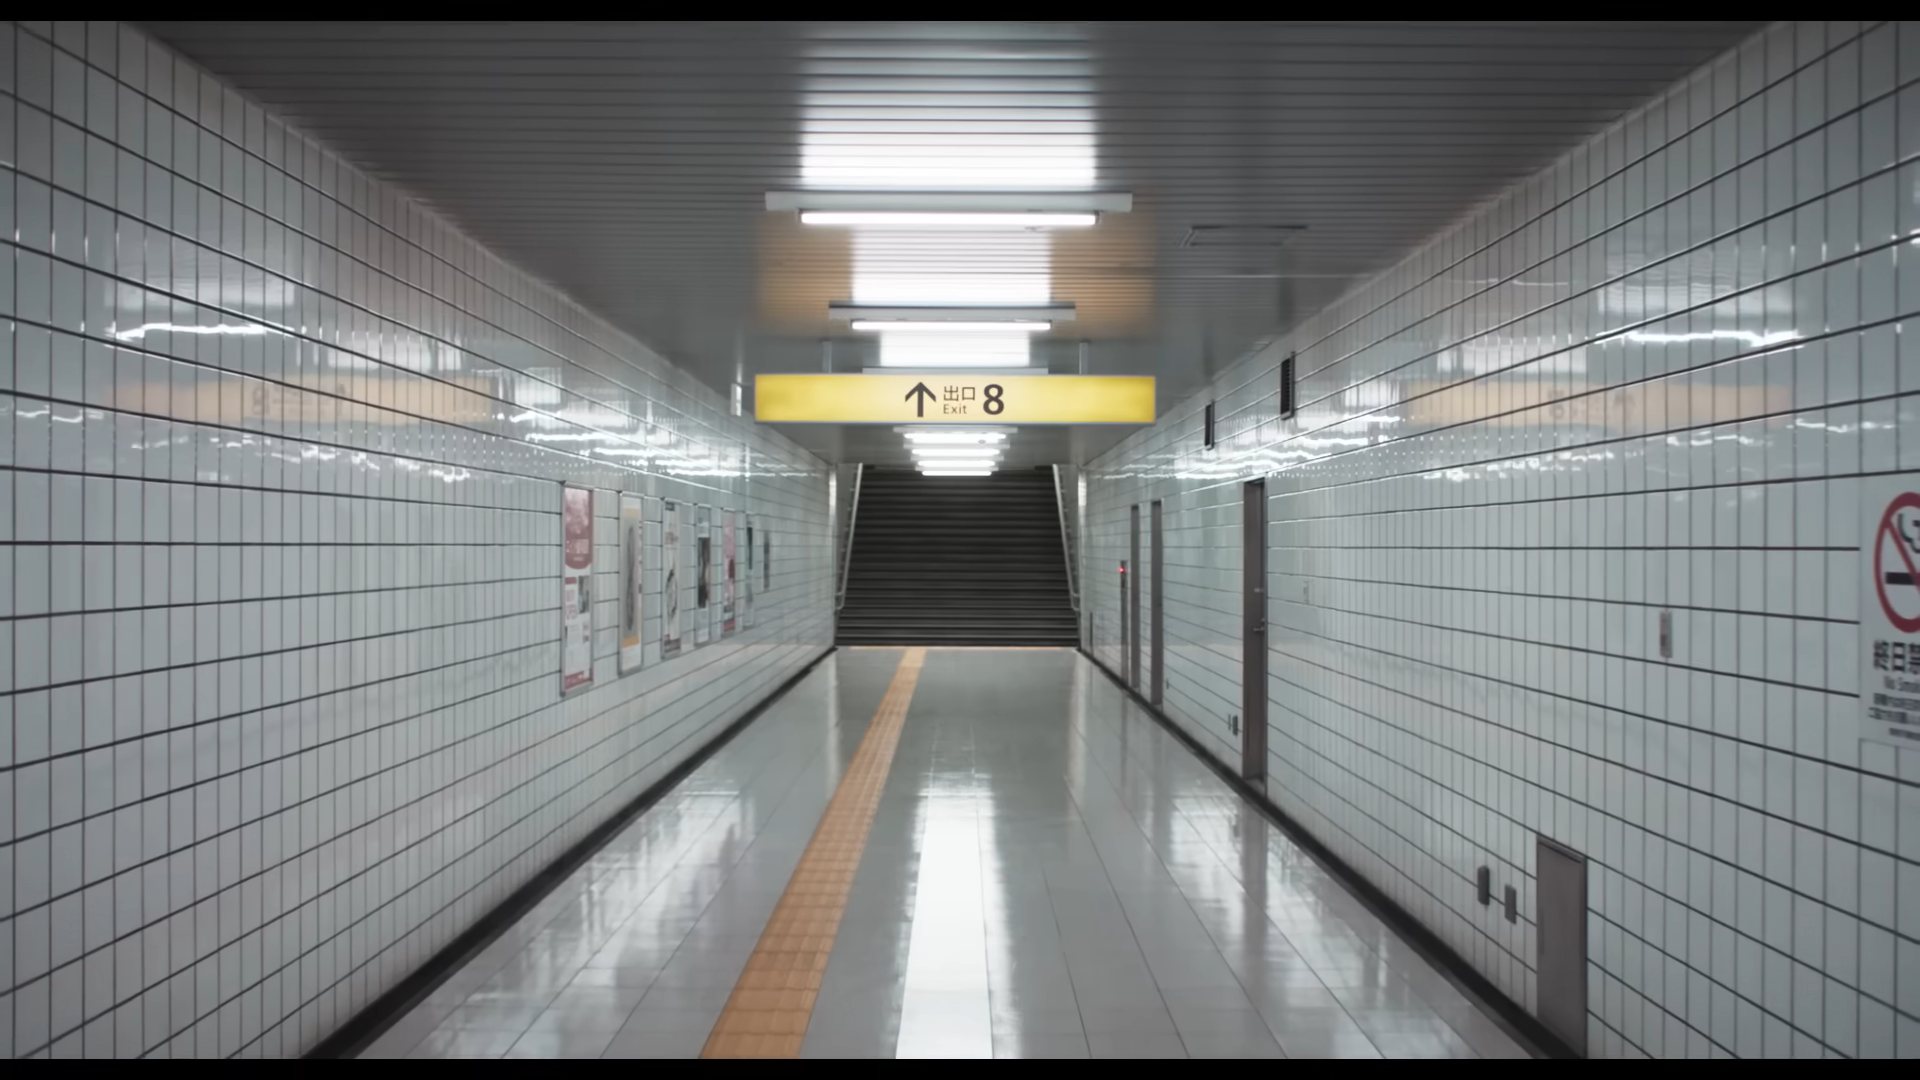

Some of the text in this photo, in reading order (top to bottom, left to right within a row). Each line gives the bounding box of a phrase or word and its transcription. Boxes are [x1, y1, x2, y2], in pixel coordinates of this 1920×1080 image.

[943, 383, 1004, 415] 出口 8
[943, 403, 967, 414] Exit
